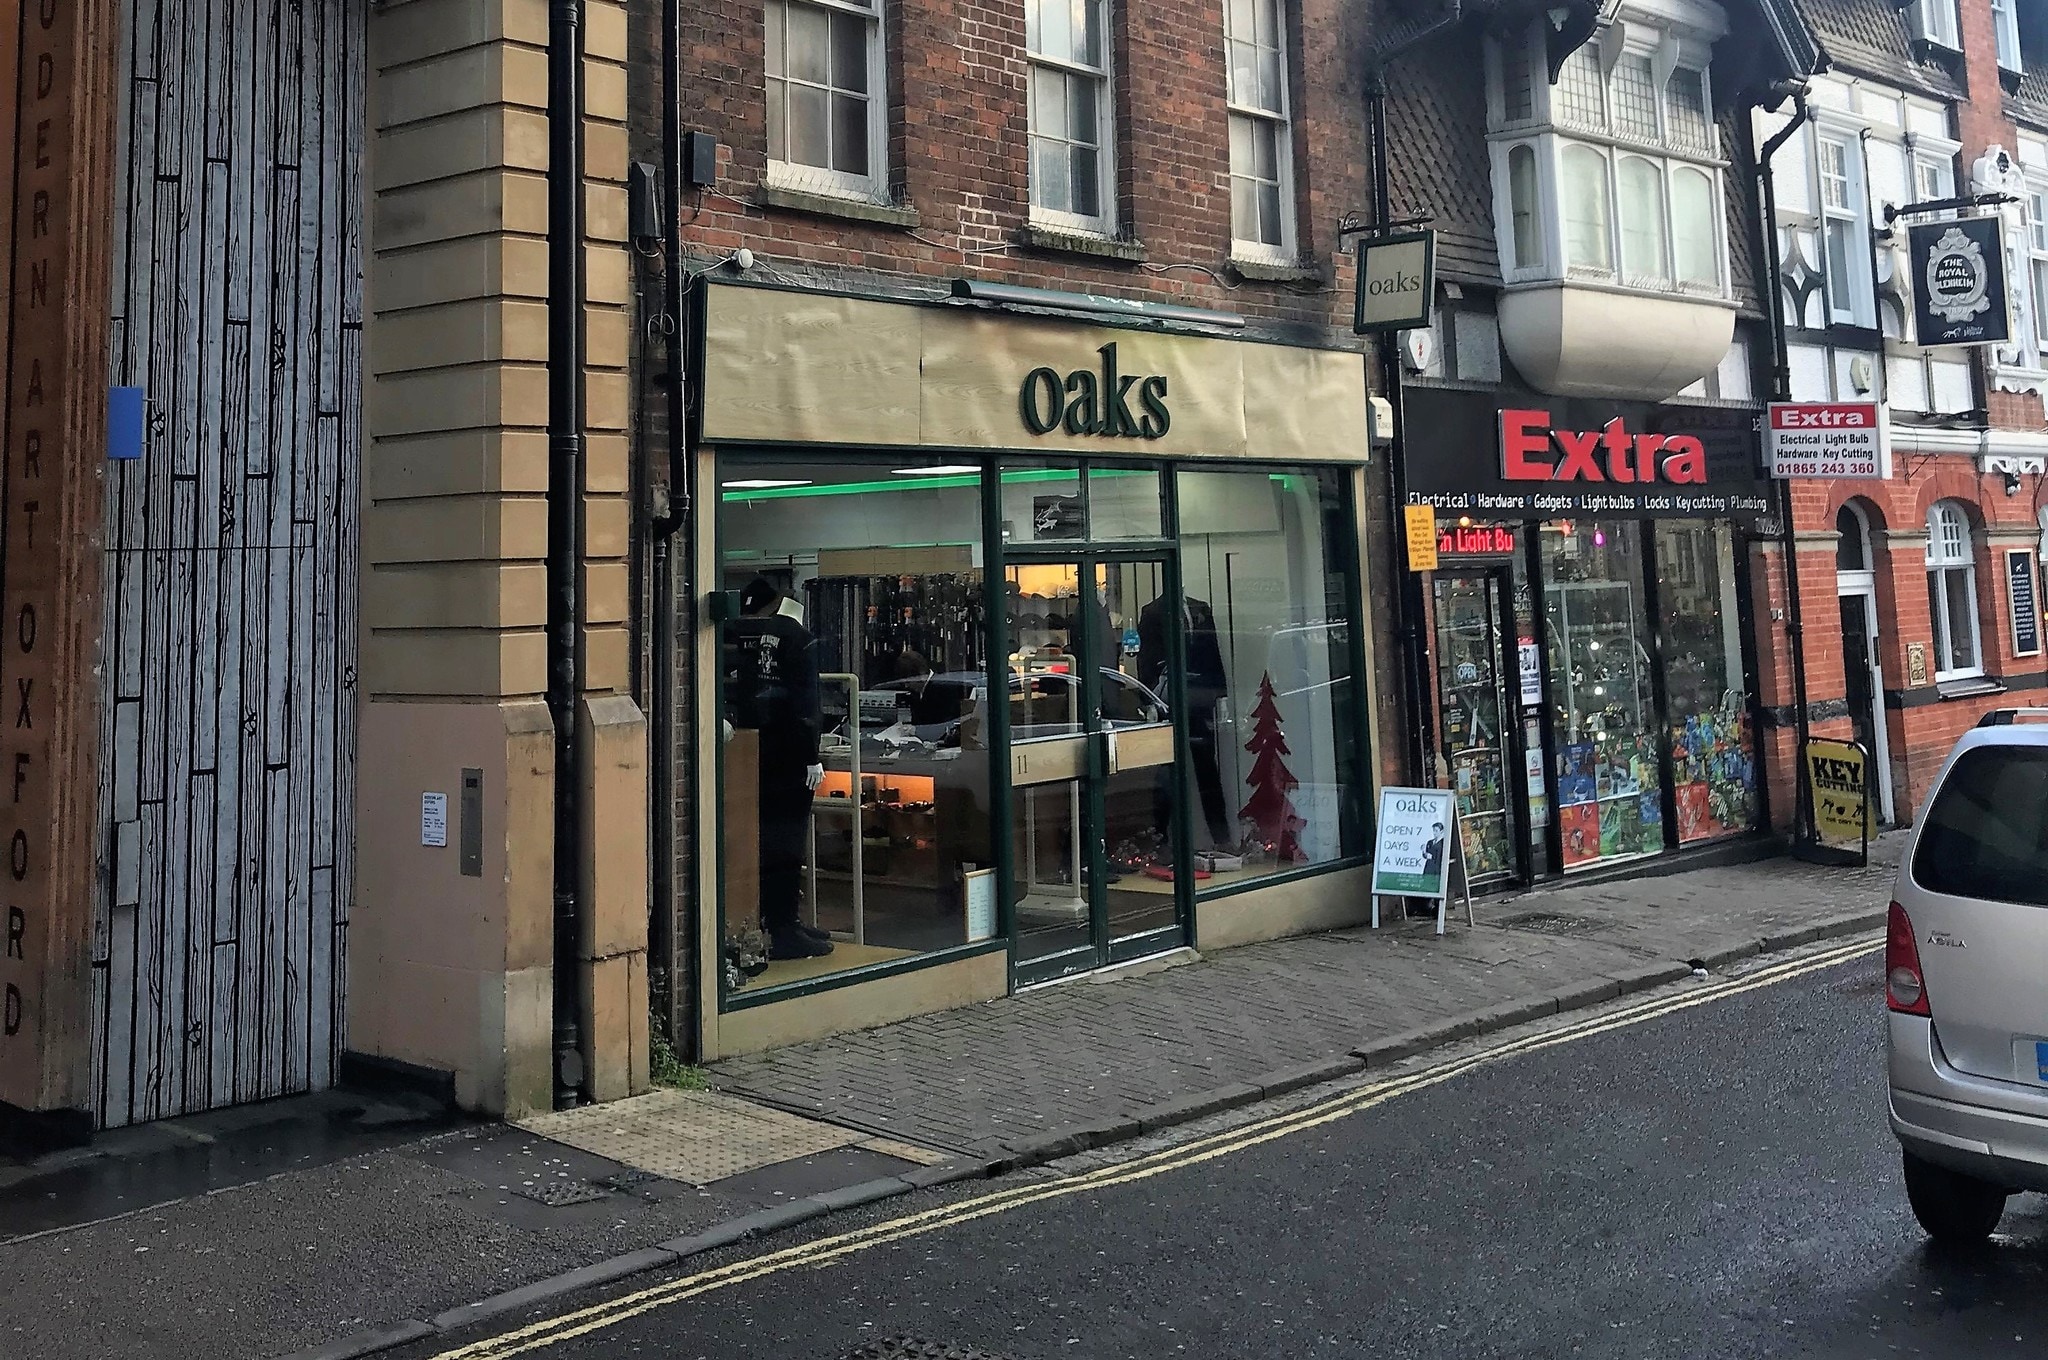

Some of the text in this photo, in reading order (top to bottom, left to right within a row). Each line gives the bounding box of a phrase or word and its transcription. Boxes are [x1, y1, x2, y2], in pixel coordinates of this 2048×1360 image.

[1943, 258, 1964, 268] THE
[1369, 271, 1421, 296] oaks
[1938, 268, 1969, 279] ROYAL
[1019, 341, 1171, 439] oaks
[1781, 409, 1865, 427] Extra
[1498, 408, 1708, 485] Extra
[1780, 433, 1869, 447] Electrical Light Bulb
[24, 358, 44, 549] ART
[1777, 447, 1874, 461] Hardware Key Cutting
[1777, 463, 1875, 474] 01865 243 360
[1409, 492, 1470, 509] Electrical
[1477, 493, 1525, 509] Hardware
[1534, 494, 1573, 512] Gadgets
[1644, 495, 1670, 509] Locks
[1730, 495, 1767, 513] Plumbing
[1456, 528, 1493, 553] Light
[1494, 528, 1514, 552] Bu
[1017, 754, 1028, 775] 11
[1811, 756, 1861, 784] KEY
[1396, 794, 1438, 814] oaks
[5, 602, 37, 1036] OXFORD
[1385, 825, 1423, 836] OPEN 7
[1383, 840, 1410, 852] DAYS
[1382, 856, 1422, 868] A WEEK
